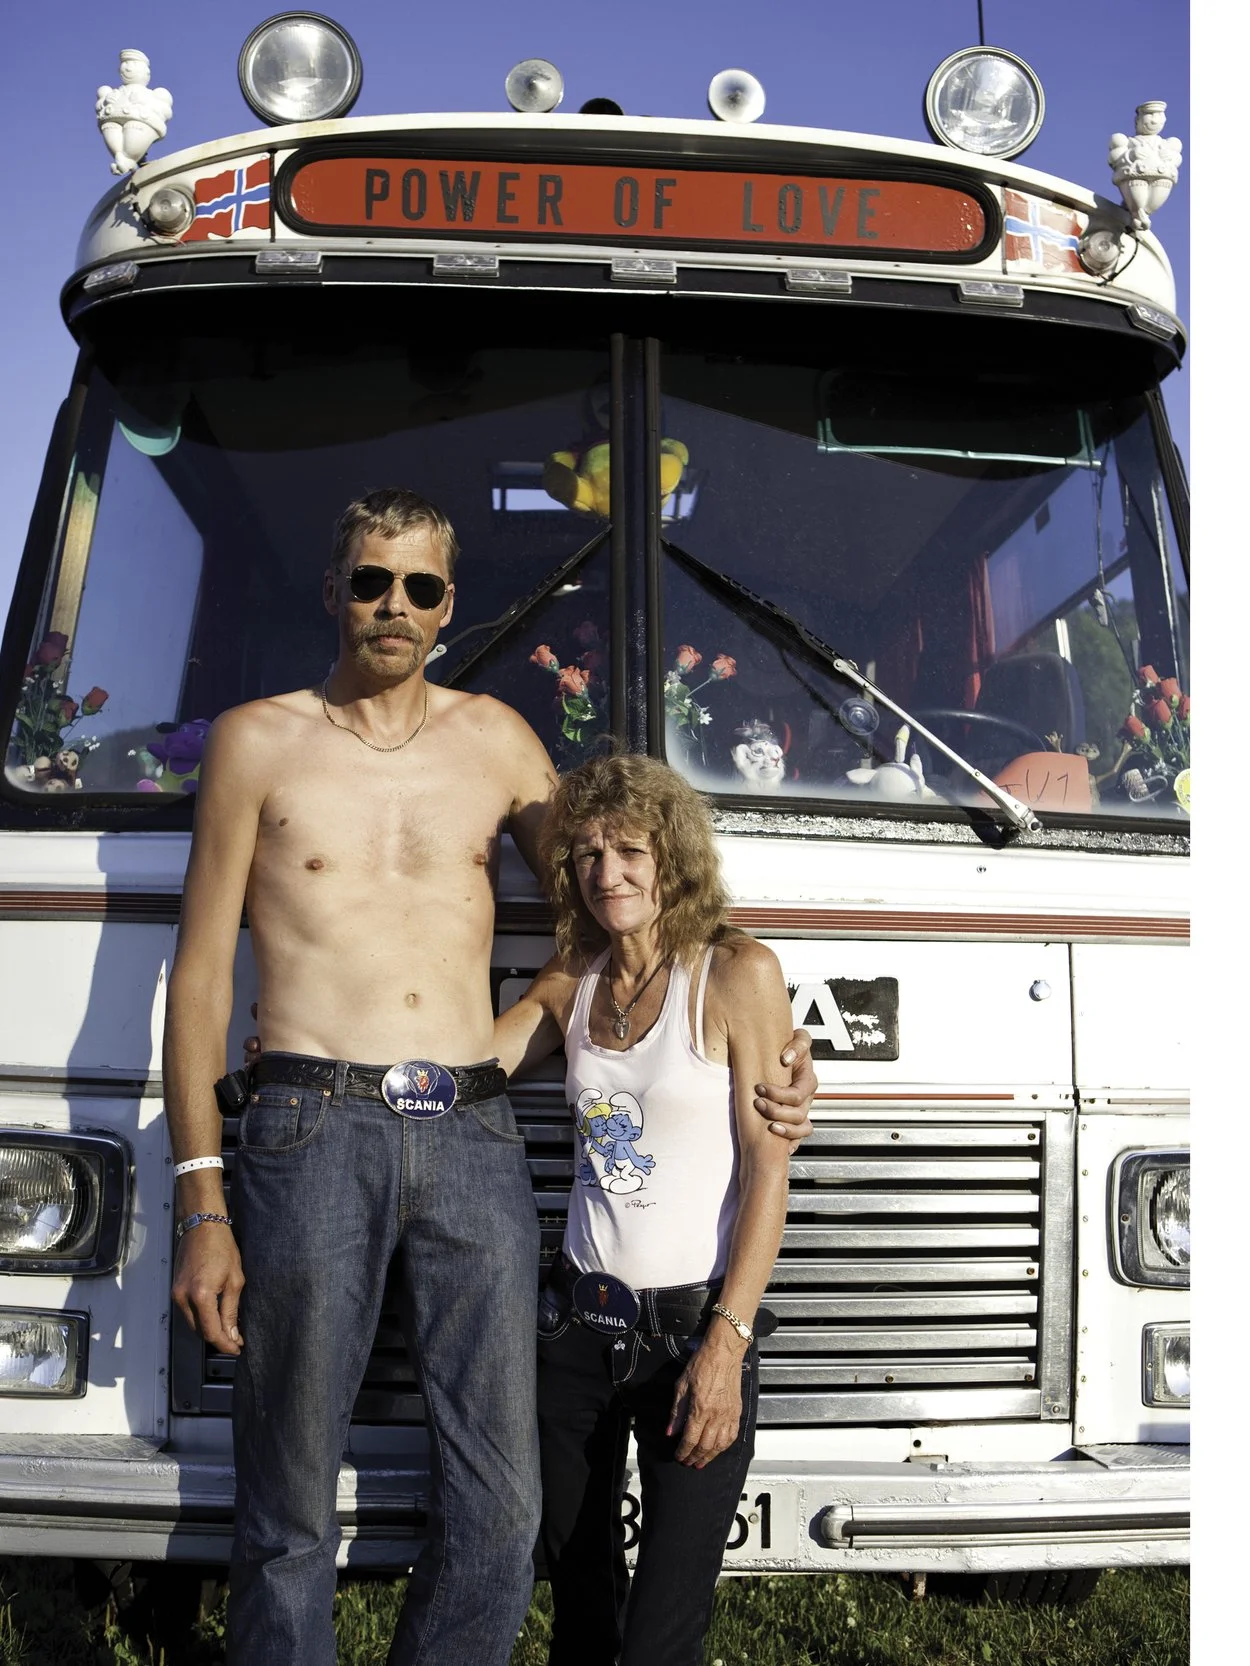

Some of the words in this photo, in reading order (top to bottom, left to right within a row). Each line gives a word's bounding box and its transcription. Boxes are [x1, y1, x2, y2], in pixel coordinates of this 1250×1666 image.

[365, 168, 564, 226] POWER
[613, 176, 677, 229] OF
[742, 181, 881, 240] LOVE
[396, 1097, 445, 1112] SCANIA
[583, 1310, 628, 1329] SCANIA
